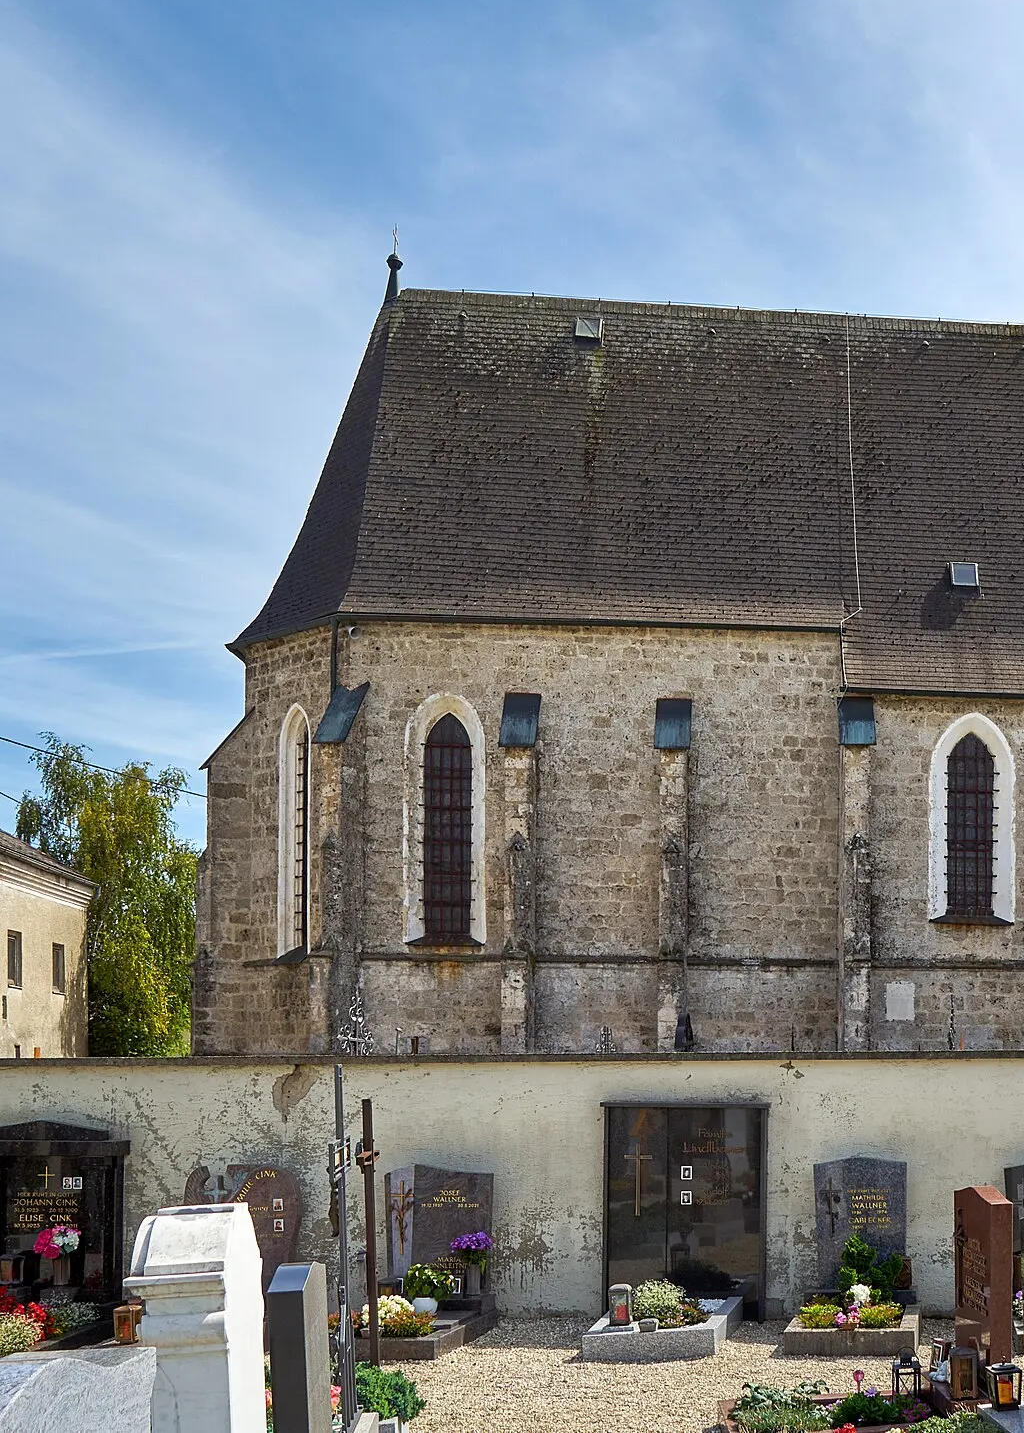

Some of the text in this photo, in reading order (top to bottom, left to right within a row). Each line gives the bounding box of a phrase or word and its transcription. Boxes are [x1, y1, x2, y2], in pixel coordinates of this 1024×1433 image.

[13, 1198, 78, 1206] JOHANN CINK
[19, 1214, 73, 1222] ELISE CINK
